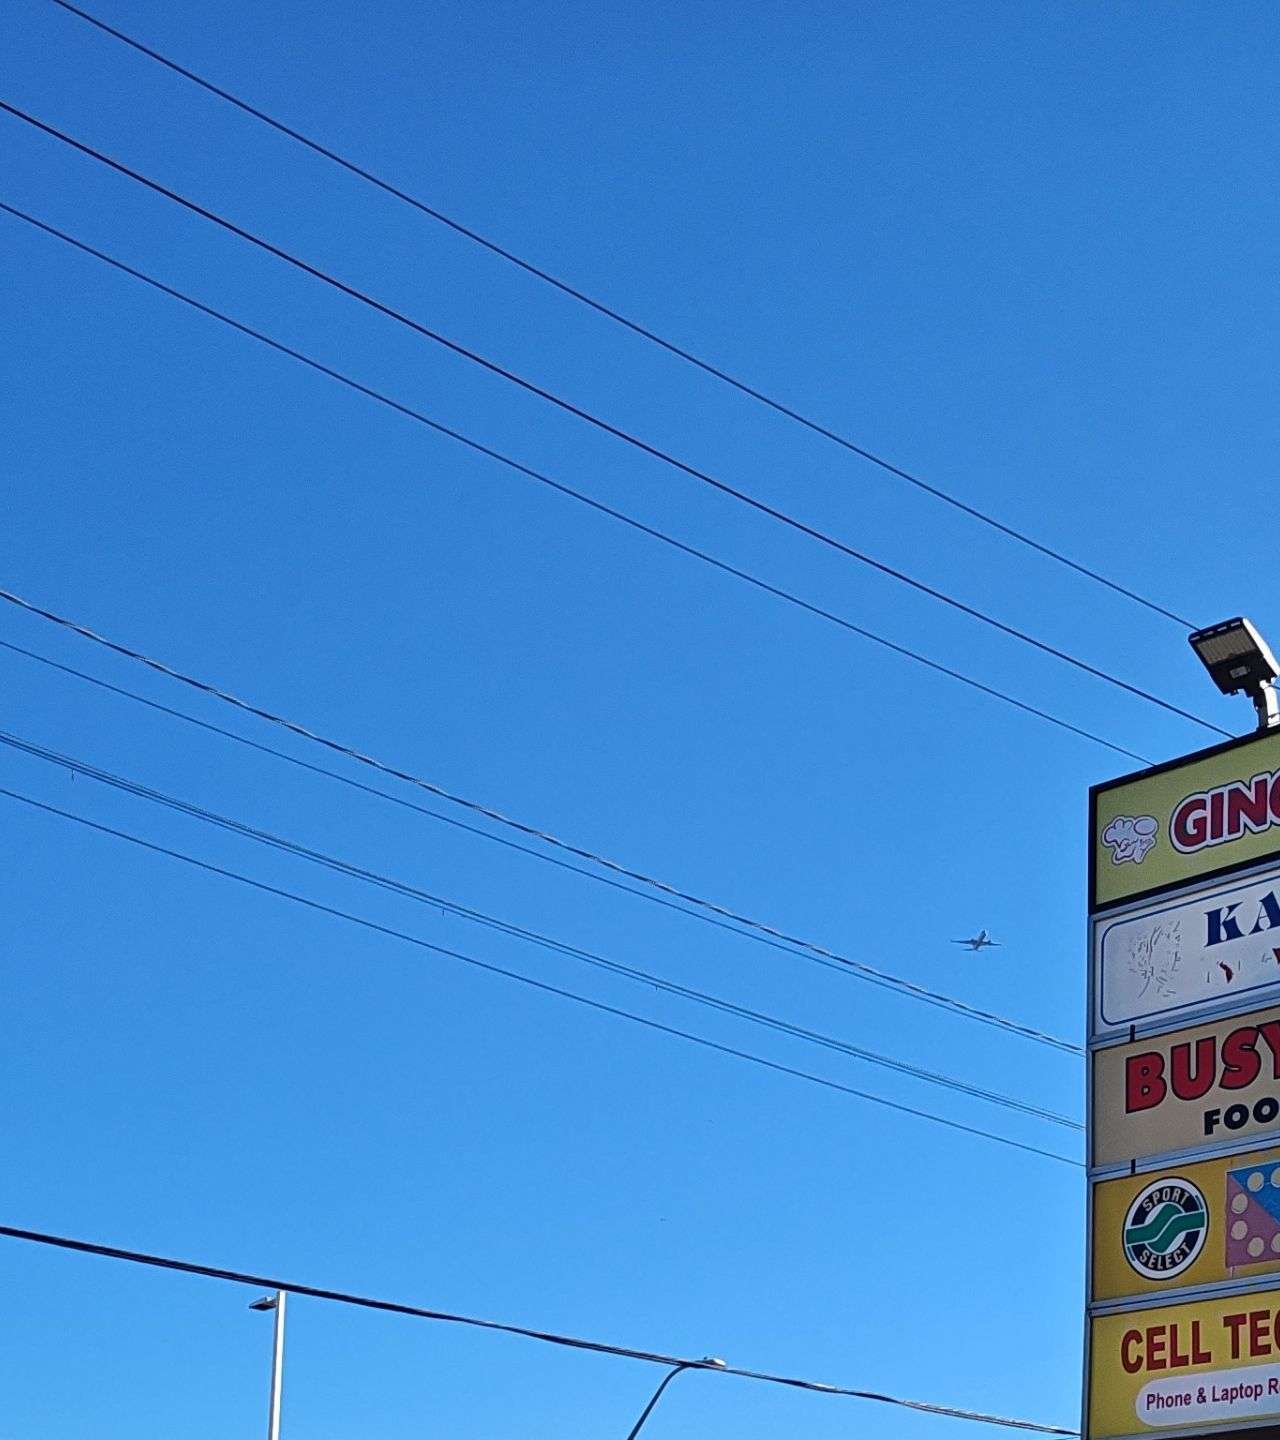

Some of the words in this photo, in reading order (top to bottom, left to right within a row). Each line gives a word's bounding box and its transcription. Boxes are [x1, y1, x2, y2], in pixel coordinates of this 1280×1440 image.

[1142, 1188, 1190, 1212] SPORT
[1139, 1243, 1190, 1270] SELECT
[1120, 1320, 1213, 1374] CELL
[1146, 1391, 1192, 1411] Phone
[1196, 1387, 1207, 1404] &
[1211, 1381, 1263, 1405] Laptop
